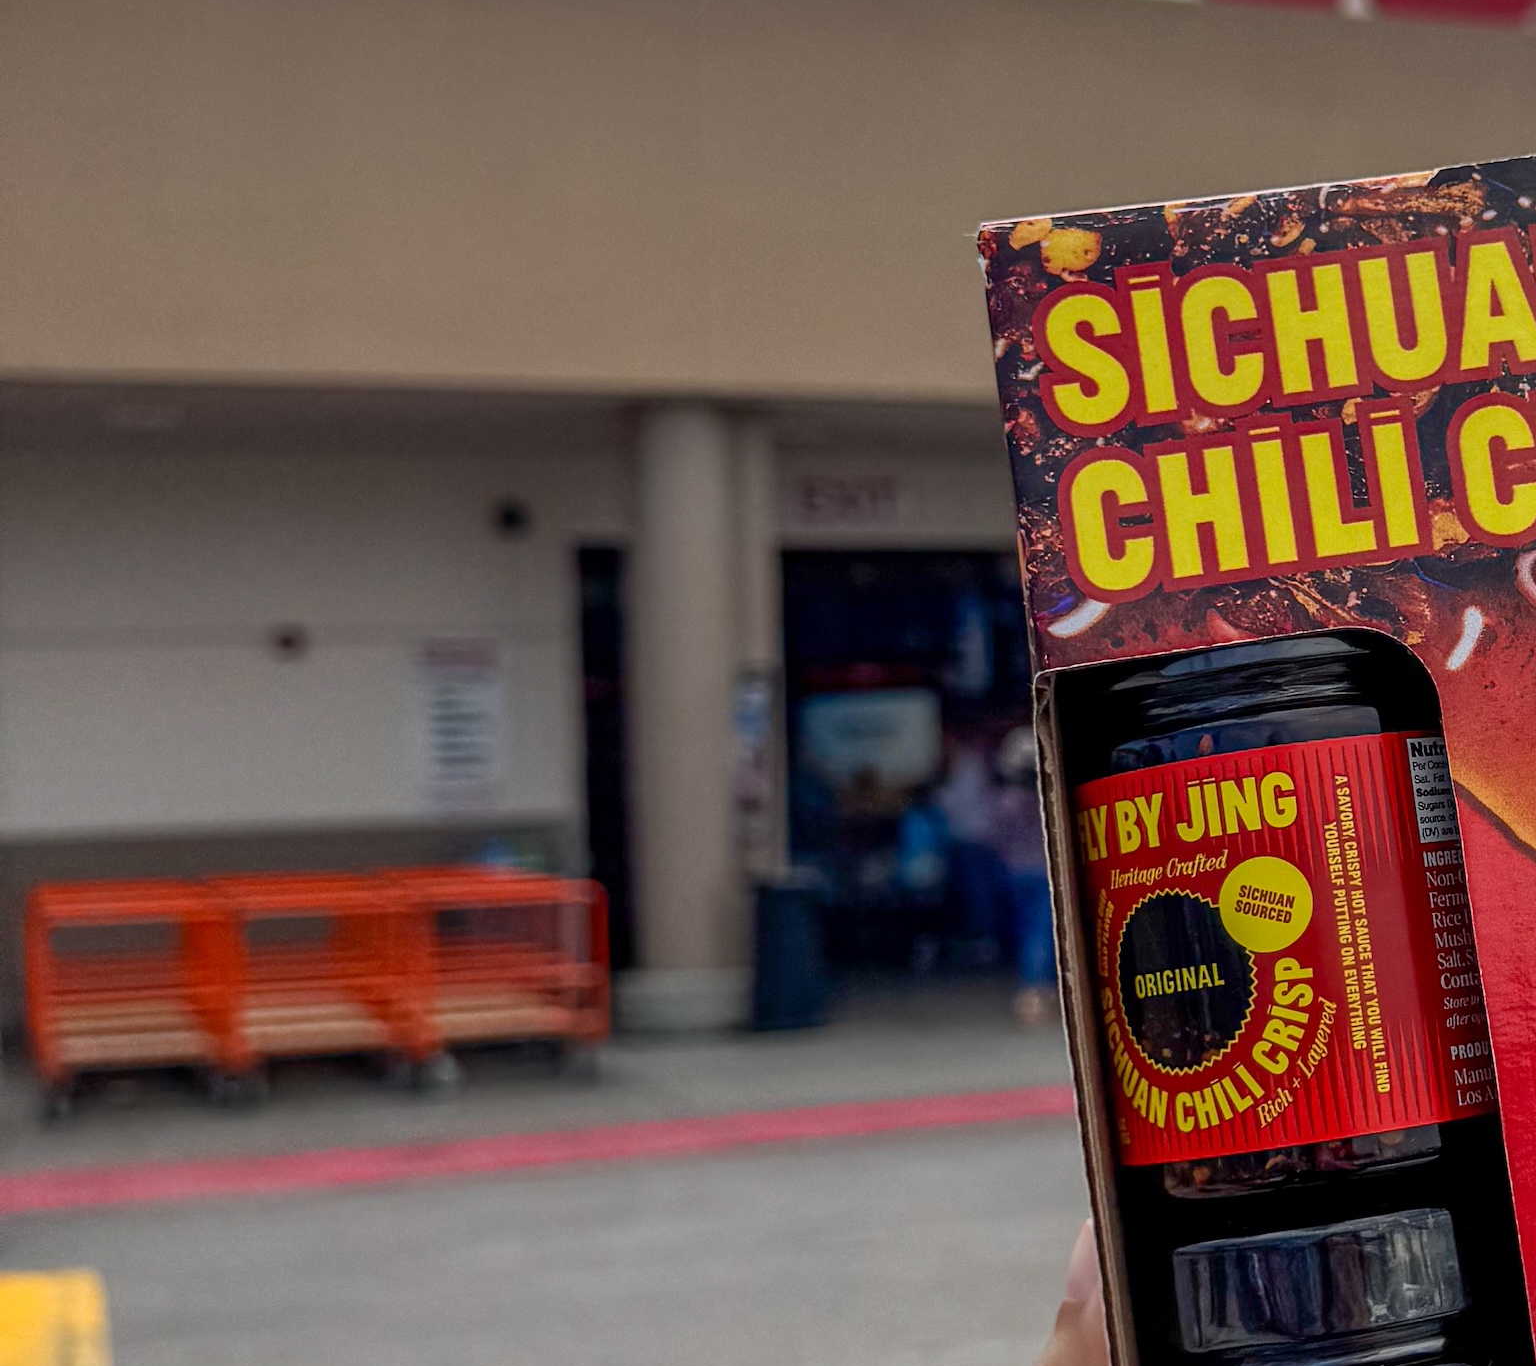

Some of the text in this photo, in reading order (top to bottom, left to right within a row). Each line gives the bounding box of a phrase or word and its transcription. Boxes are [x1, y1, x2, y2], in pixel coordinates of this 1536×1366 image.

[1335, 775, 1348, 784] A
[1115, 792, 1163, 854] BY
[1336, 787, 1356, 839] SAVORY,
[1110, 849, 1229, 890] Heritage Crafted
[1324, 822, 1345, 886] YOURSELF
[1341, 947, 1355, 966] ON
[1351, 890, 1366, 915] HOT
[1235, 899, 1292, 924] SOURCED
[1432, 911, 1461, 928] Rice
[1355, 918, 1372, 960] SAUCE
[1134, 963, 1225, 999] ORIGINAL
[1361, 962, 1377, 995] THAT
[1366, 998, 1382, 1025] YOU
[1444, 996, 1469, 1010] Store
[1446, 1013, 1470, 1029] after
[1256, 1087, 1293, 1128] Rich
[1296, 997, 1337, 1079] Layered
[1457, 1089, 1482, 1106] Los
